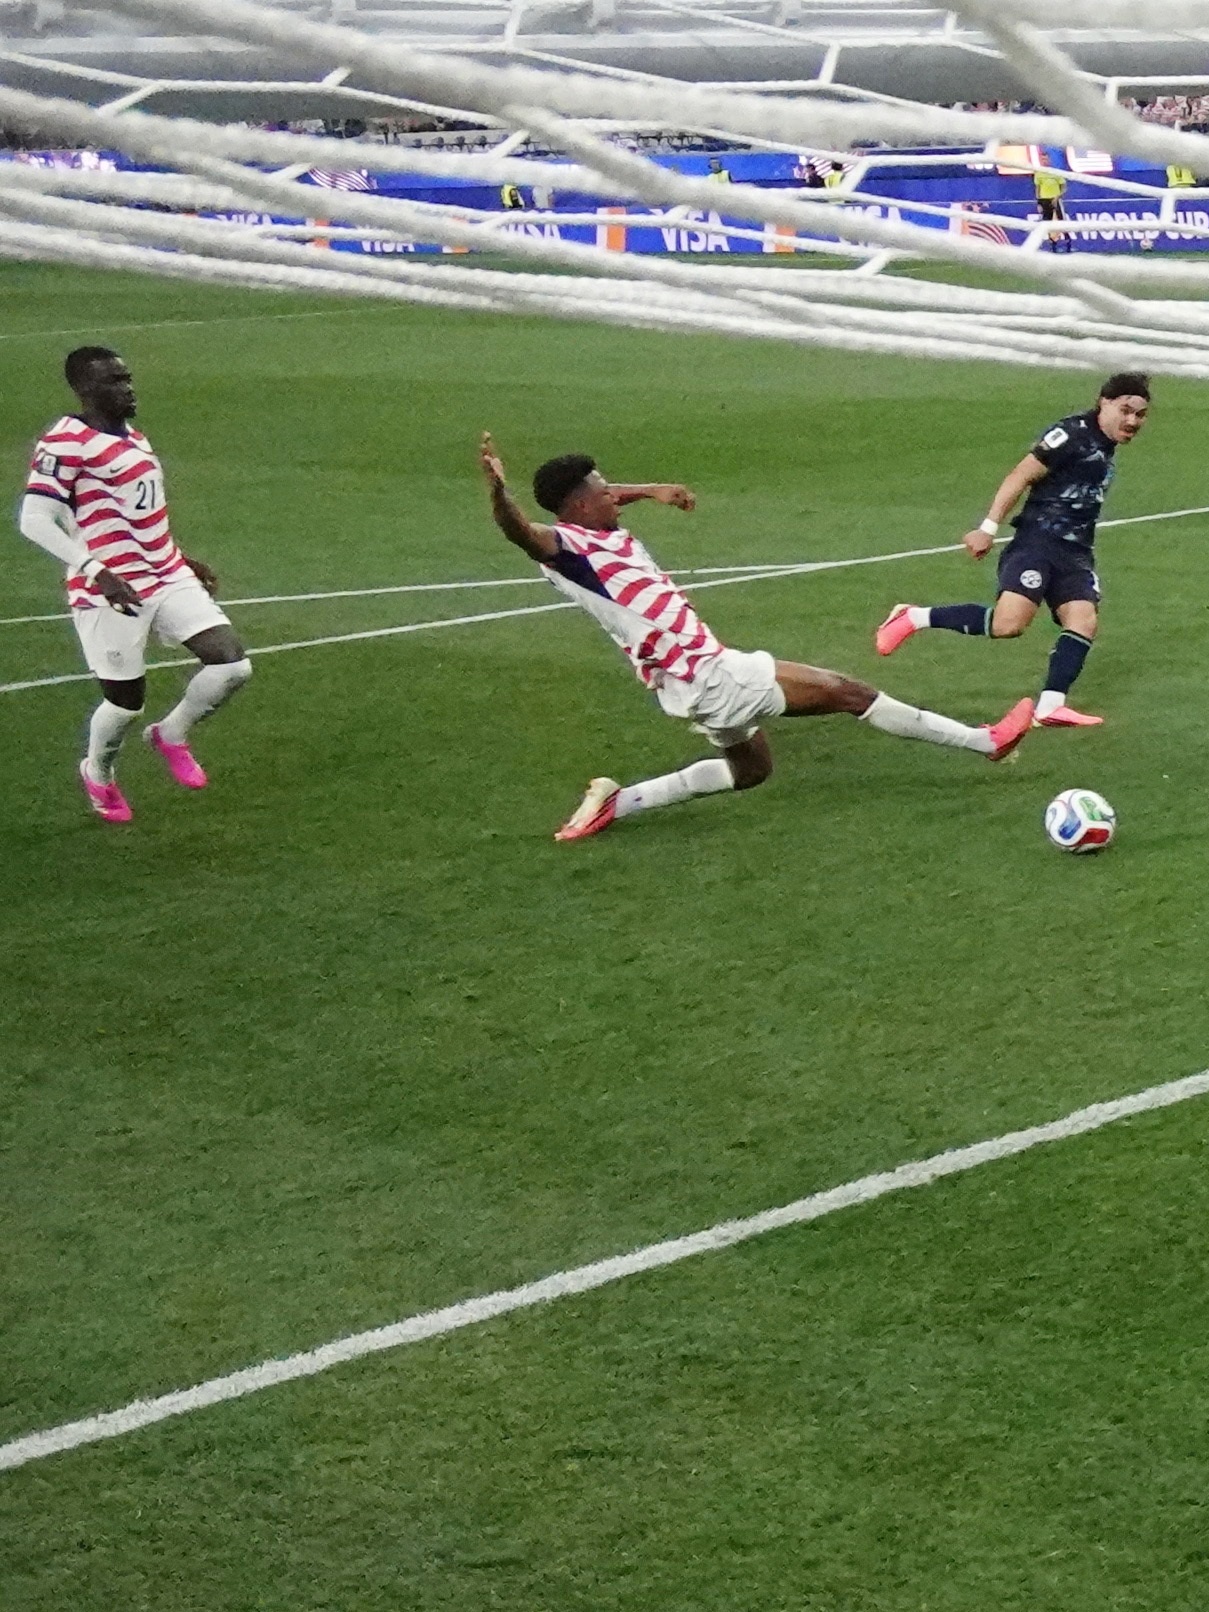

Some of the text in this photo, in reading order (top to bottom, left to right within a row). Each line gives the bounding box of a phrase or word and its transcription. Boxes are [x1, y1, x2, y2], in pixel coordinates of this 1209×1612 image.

[650, 208, 731, 252] VISA
[1026, 212, 1078, 240] FA
[1076, 211, 1160, 241] WORLD
[135, 479, 156, 510] 21
